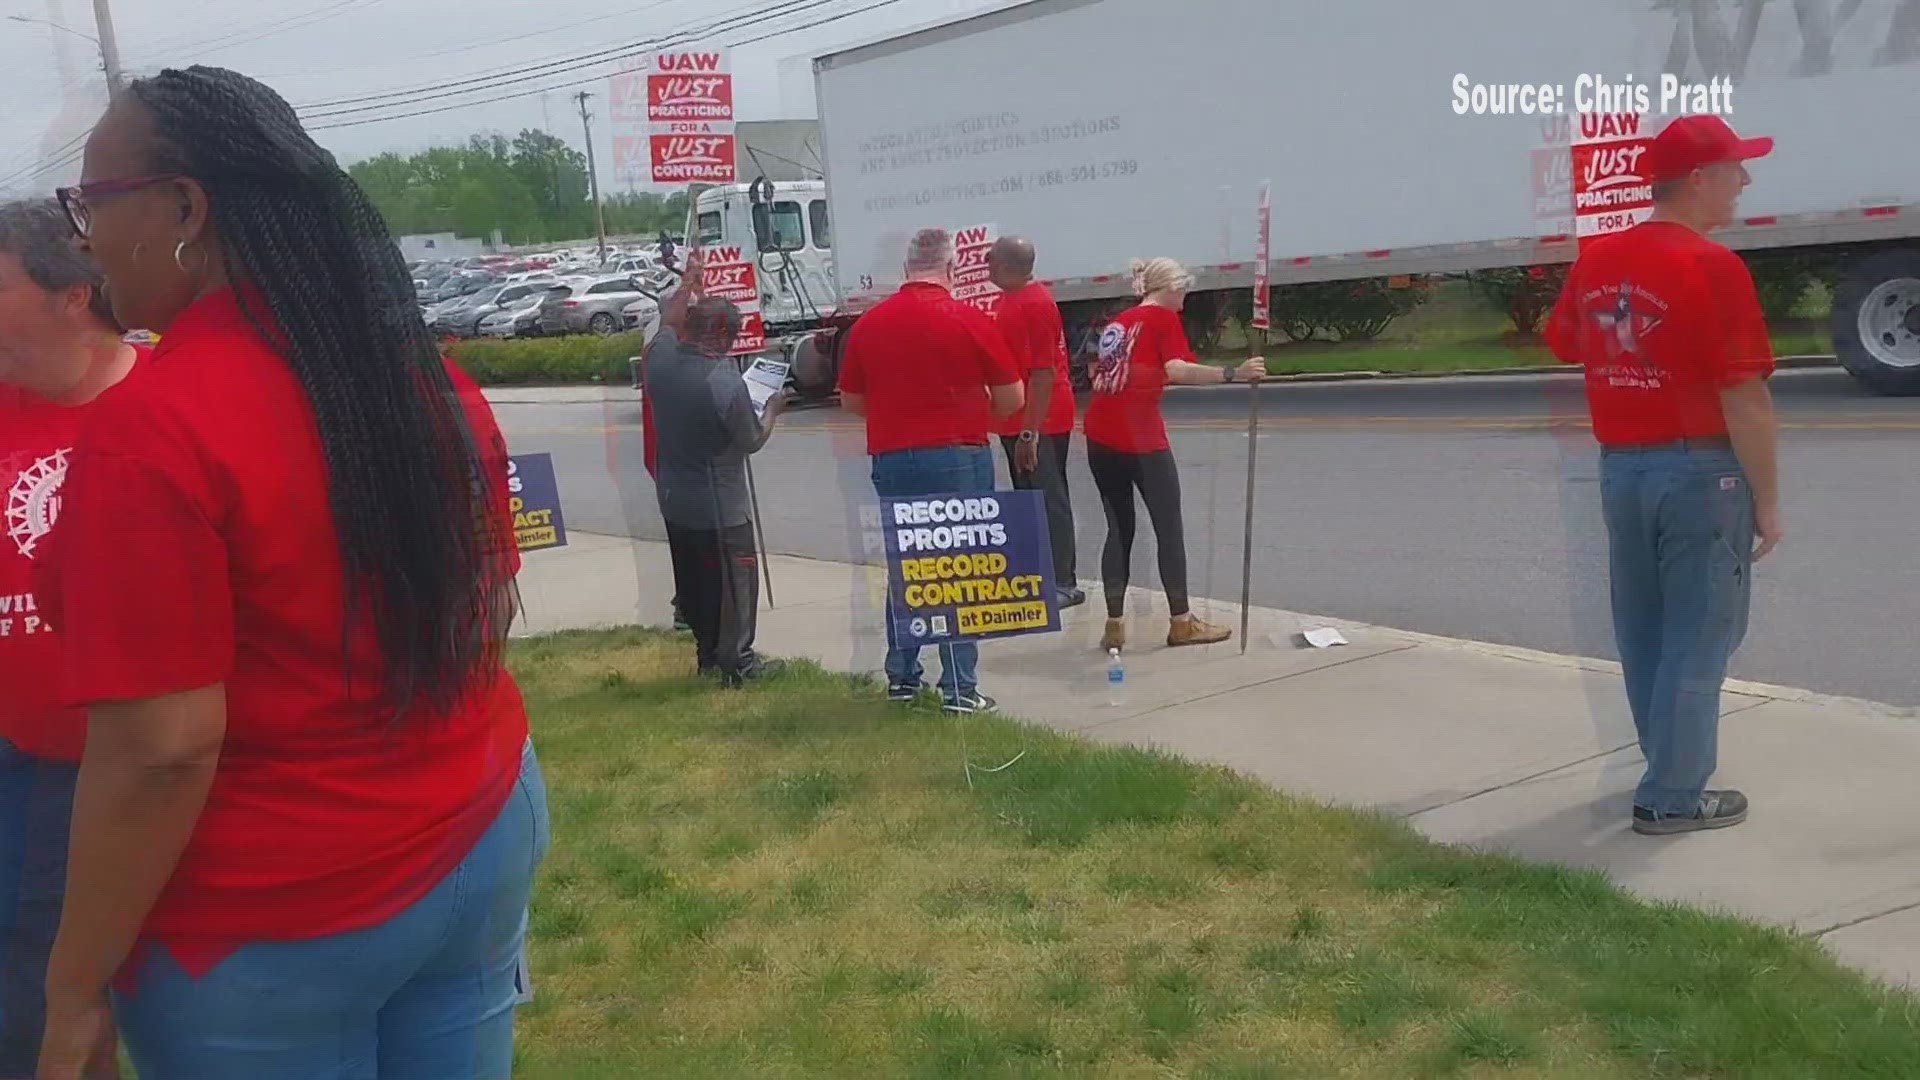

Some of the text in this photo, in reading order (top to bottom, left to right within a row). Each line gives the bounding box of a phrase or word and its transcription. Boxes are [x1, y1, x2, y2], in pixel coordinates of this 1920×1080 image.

[658, 53, 719, 70] UAW
[658, 77, 723, 101] JUST
[650, 104, 731, 117] PRACTICING
[671, 122, 711, 133] FOR A
[1581, 111, 1640, 138] UAW
[661, 136, 726, 161] JUST
[653, 164, 733, 178] CONTRACT
[1584, 145, 1647, 184] JUST
[1577, 185, 1653, 209] PRACTICING
[1598, 212, 1636, 231] FOR A
[956, 227, 987, 246] AW
[703, 246, 741, 264] AW
[956, 246, 991, 267] UST
[860, 273, 873, 290] 53
[955, 286, 977, 298] FOR
[893, 497, 1000, 525] RECORD
[897, 523, 1007, 552] PROFITS
[901, 553, 1007, 582] RECORD
[905, 575, 1043, 608] CONTRACT
[961, 607, 1042, 628] at Daimler
